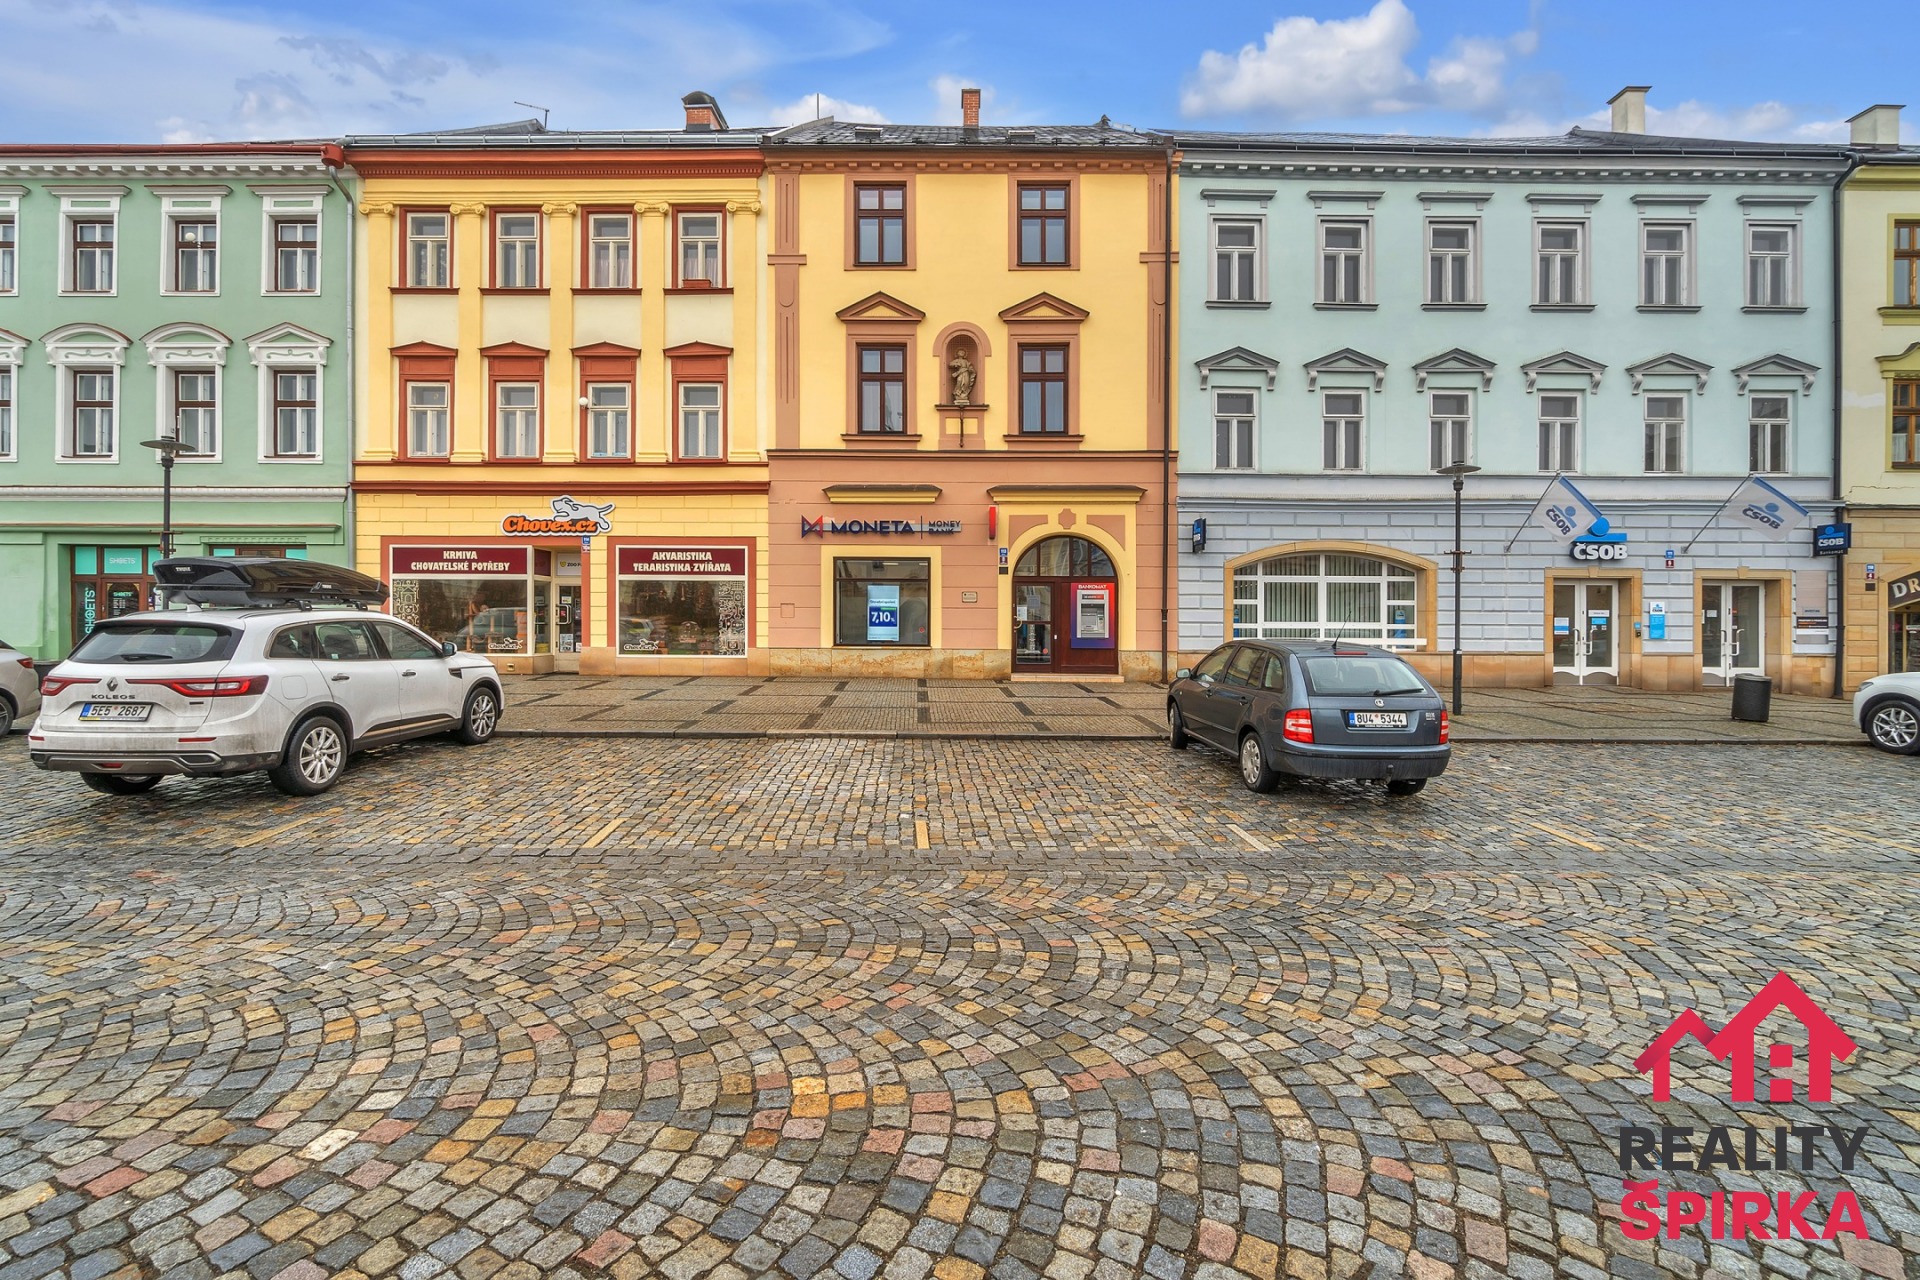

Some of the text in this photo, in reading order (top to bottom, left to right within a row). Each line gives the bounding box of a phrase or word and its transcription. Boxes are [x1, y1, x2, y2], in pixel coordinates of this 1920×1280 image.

[928, 520, 961, 528] MONEY
[1546, 508, 1571, 536] ČSOB
[1742, 507, 1781, 529] ČSOB
[503, 516, 598, 533] Chovex.cz
[831, 520, 915, 534] MONETA
[443, 550, 478, 560] KRMIVA
[652, 551, 712, 561] AKVARISTIKA
[1573, 543, 1628, 560] ČSOB
[411, 560, 510, 571] CHOVATELSKÉ POTŘEBY
[91, 705, 112, 716] 5E5
[118, 705, 146, 717] 2687
[1356, 713, 1403, 724] 8U4 5344
